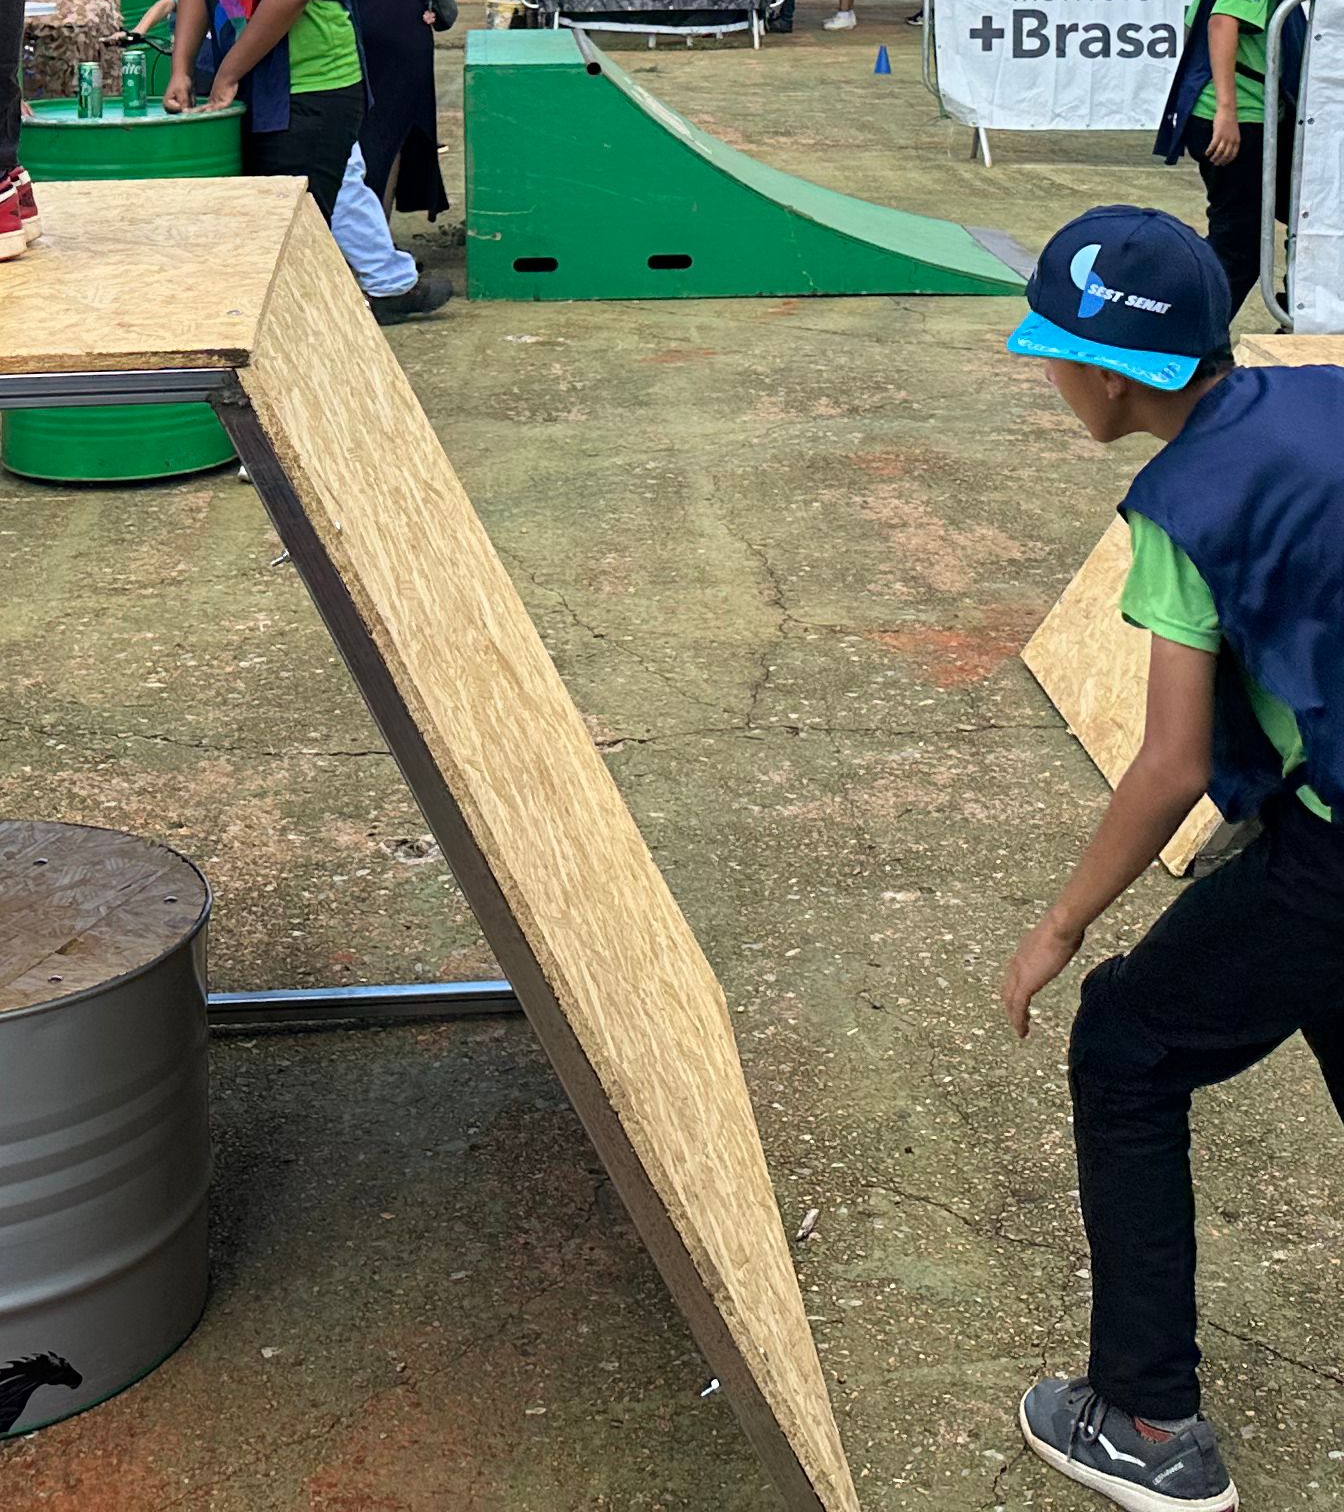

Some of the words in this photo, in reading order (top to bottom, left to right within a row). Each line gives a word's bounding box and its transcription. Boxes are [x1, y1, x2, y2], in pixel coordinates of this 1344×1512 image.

[969, 5, 1191, 59] +Brasa
[1087, 283, 1125, 303] SEST
[1124, 294, 1173, 314] SENAT
